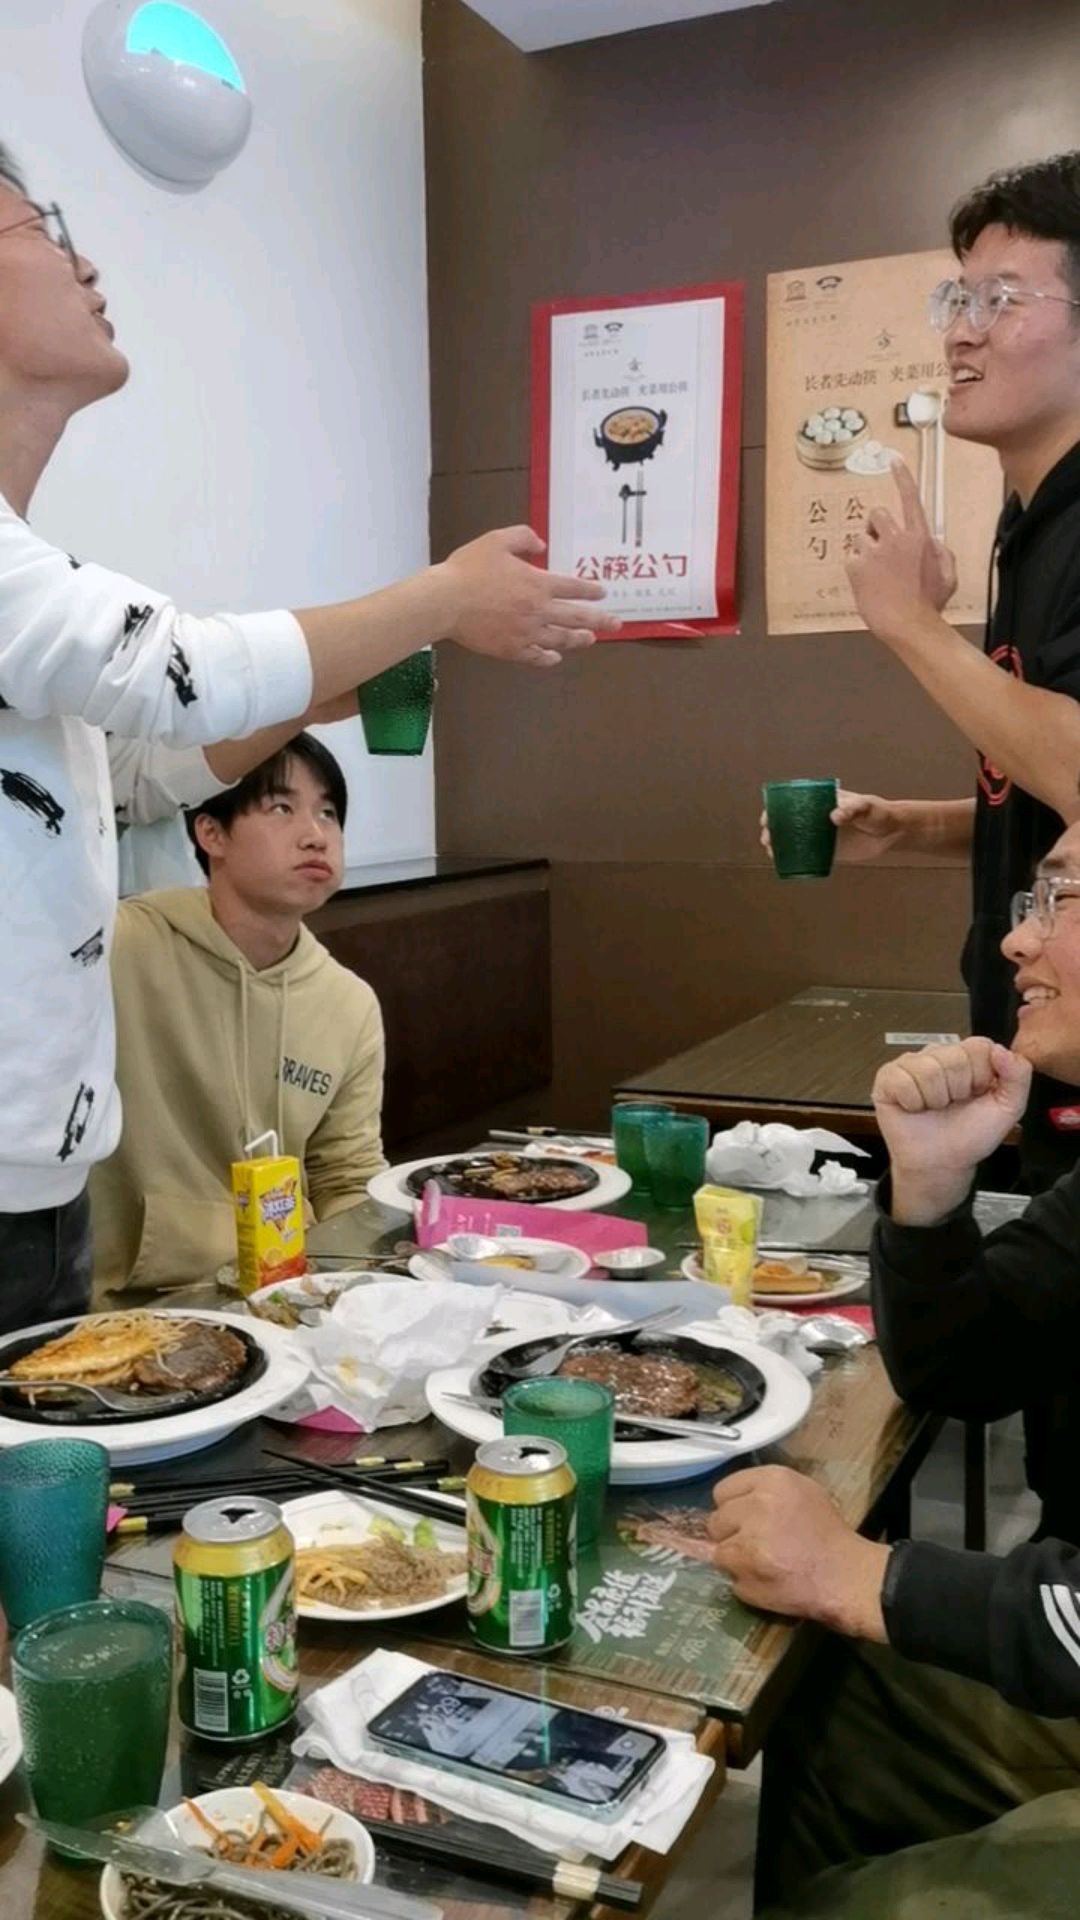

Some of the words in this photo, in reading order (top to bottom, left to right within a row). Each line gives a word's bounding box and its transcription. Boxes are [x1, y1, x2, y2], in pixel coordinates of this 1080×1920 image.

[805, 369, 877, 391] 长者先动筷
[576, 553, 688, 581] 公筷公勺
